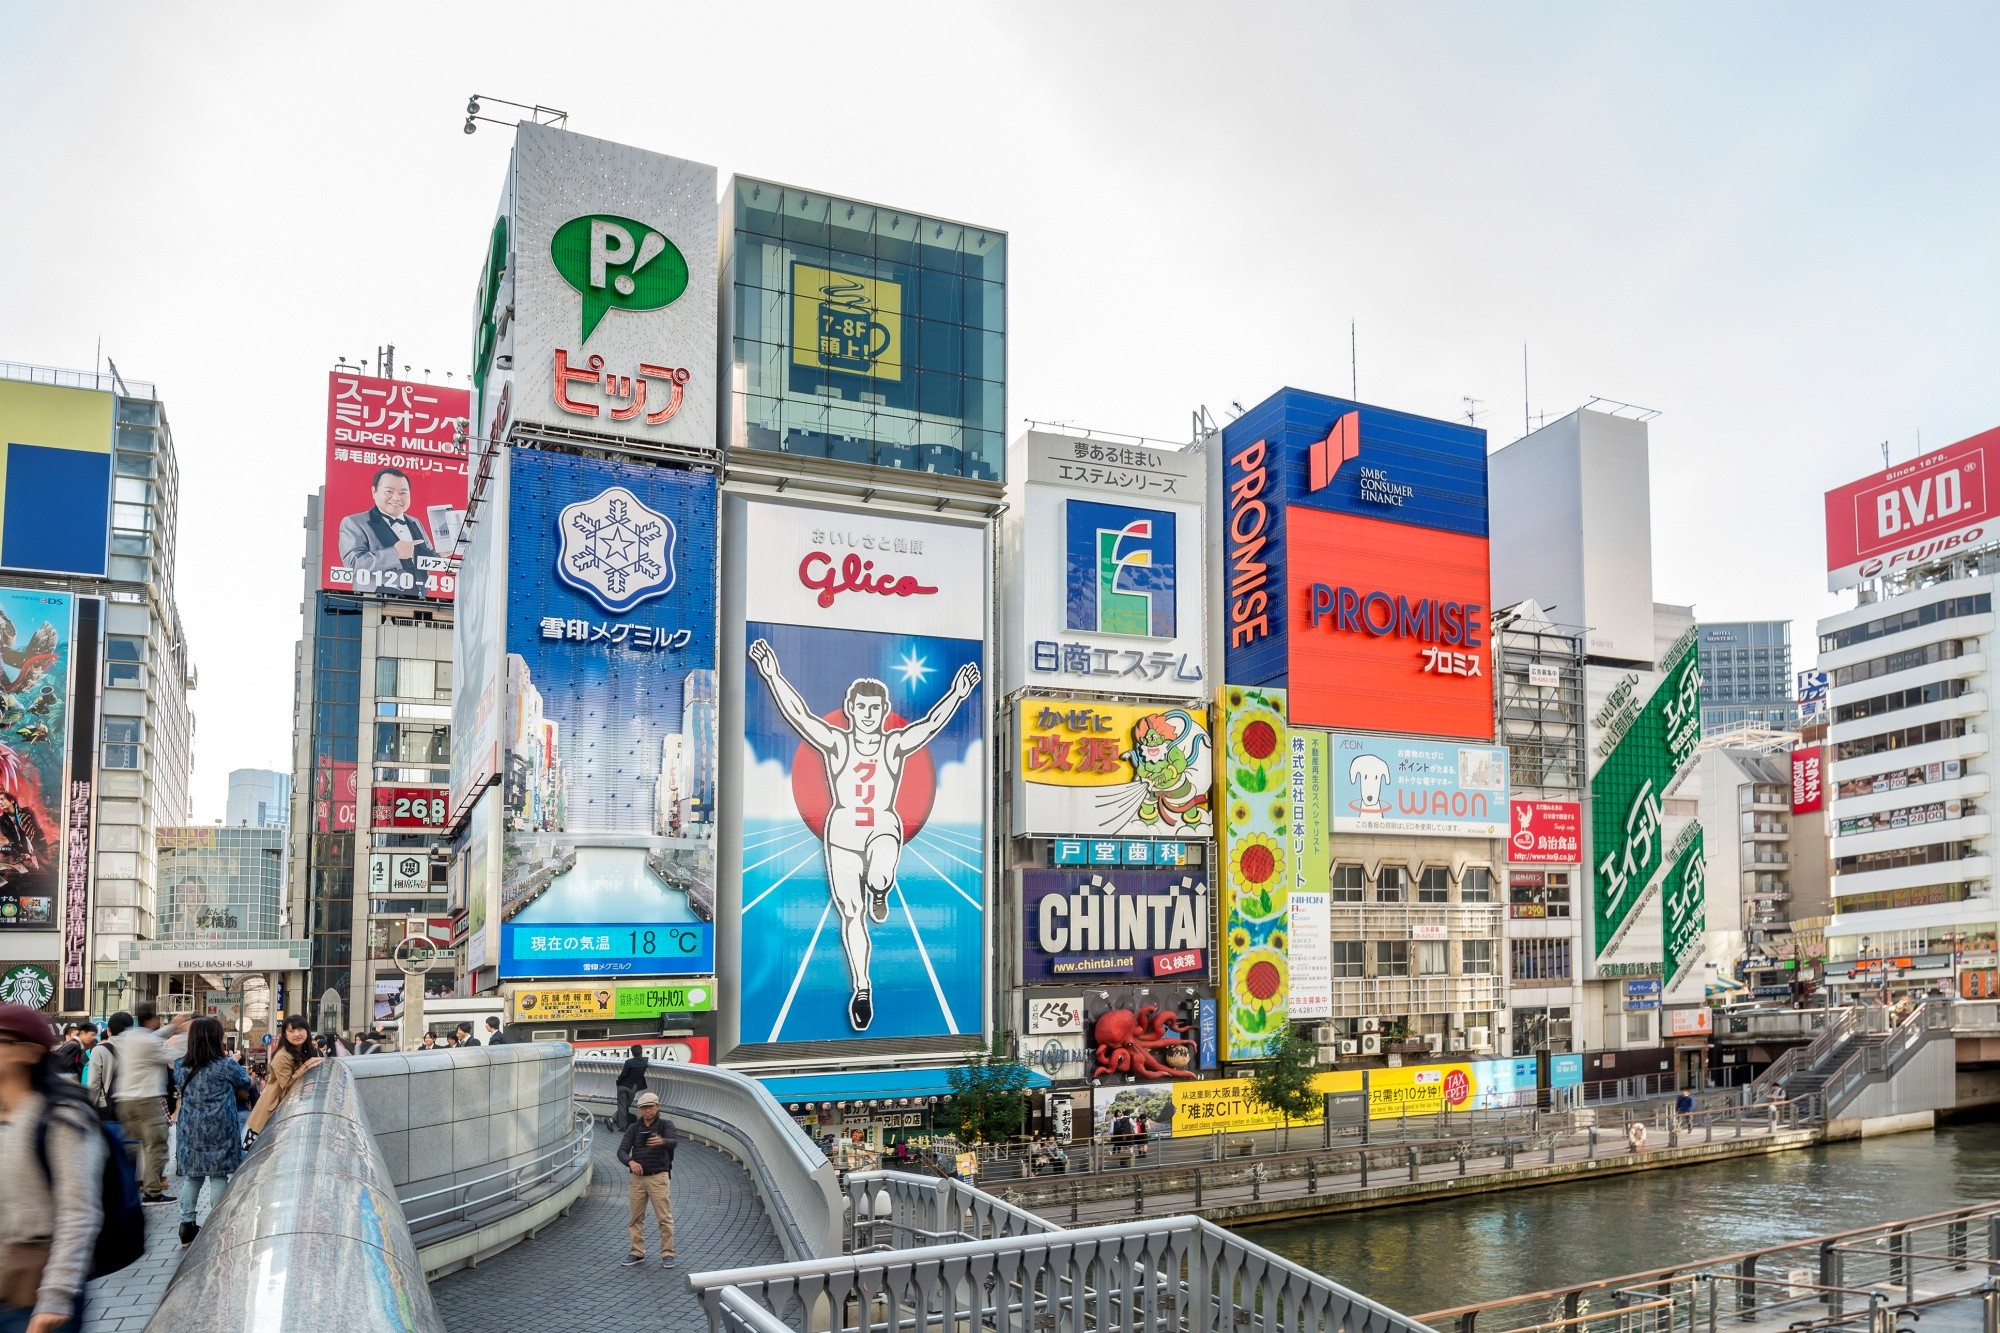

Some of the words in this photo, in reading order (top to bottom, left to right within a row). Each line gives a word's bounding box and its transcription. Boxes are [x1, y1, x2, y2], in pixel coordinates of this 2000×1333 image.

[823, 315, 867, 338] 7-8F
[336, 378, 438, 408] スーパー
[554, 348, 691, 425] ピップ
[334, 427, 396, 447] SUPER
[334, 448, 469, 475] 薄毛部分のボリューム
[1074, 442, 1162, 467] 夢ある住まい
[1059, 465, 1177, 494] エステムシリーズ
[1361, 466, 1387, 481] SMBC
[1886, 465, 1916, 481] Since
[1361, 478, 1414, 498] CONSUMER
[1361, 490, 1404, 507] FINANCE
[1877, 468, 1972, 539] B.V.D.
[812, 528, 924, 555] おいしさと健康
[1230, 439, 1268, 649] PROMISE
[1889, 528, 1984, 568] FUJIBO
[799, 551, 939, 608] Glico
[1311, 582, 1482, 647] PROMISE
[540, 616, 692, 647] 雪印メグミルク
[1034, 640, 1203, 681] 日商エステム
[1422, 647, 1482, 677] プロミス
[1596, 673, 1639, 728] いい暮らし
[1663, 659, 1704, 741] エイブル
[1037, 706, 1113, 733] かぜに
[1598, 697, 1642, 757] いい部屋で
[1028, 733, 1122, 775] 改源
[853, 759, 878, 827] グリコ
[1793, 761, 1805, 804] JOYSOUND
[1805, 757, 1821, 803] カラオケ
[395, 798, 445, 818] 268
[1311, 739, 1320, 854] 不動産再生のスペシャリスト
[1398, 788, 1487, 817] WAON
[1292, 737, 1306, 887] 株式会社日本リート
[1061, 841, 1179, 861] 戸堂歯科
[1537, 835, 1577, 850] 鳥治食品
[1600, 778, 1666, 918] エイブル
[1292, 896, 1323, 904] NIHON
[1667, 848, 1707, 933] エイブル
[205, 908, 229, 916] なんば
[1039, 874, 1207, 953] CHINTAI
[531, 936, 610, 951] 現在の気温
[629, 930, 656, 955] 18
[178, 960, 204, 968] EBISU
[583, 962, 632, 971] 雪印メグミルク
[1173, 954, 1196, 969] 検索
[541, 993, 592, 1002] 店舗情報館
[647, 990, 684, 1007] ピタットハウス
[1289, 996, 1328, 1005] 広告主募集中
[573, 1045, 680, 1062] OTTRIA
[1446, 1084, 1468, 1100] FREE!
[1447, 1072, 1465, 1089] TAX
[1182, 1122, 1199, 1130] Largest
[1212, 1120, 1230, 1129] shopping
